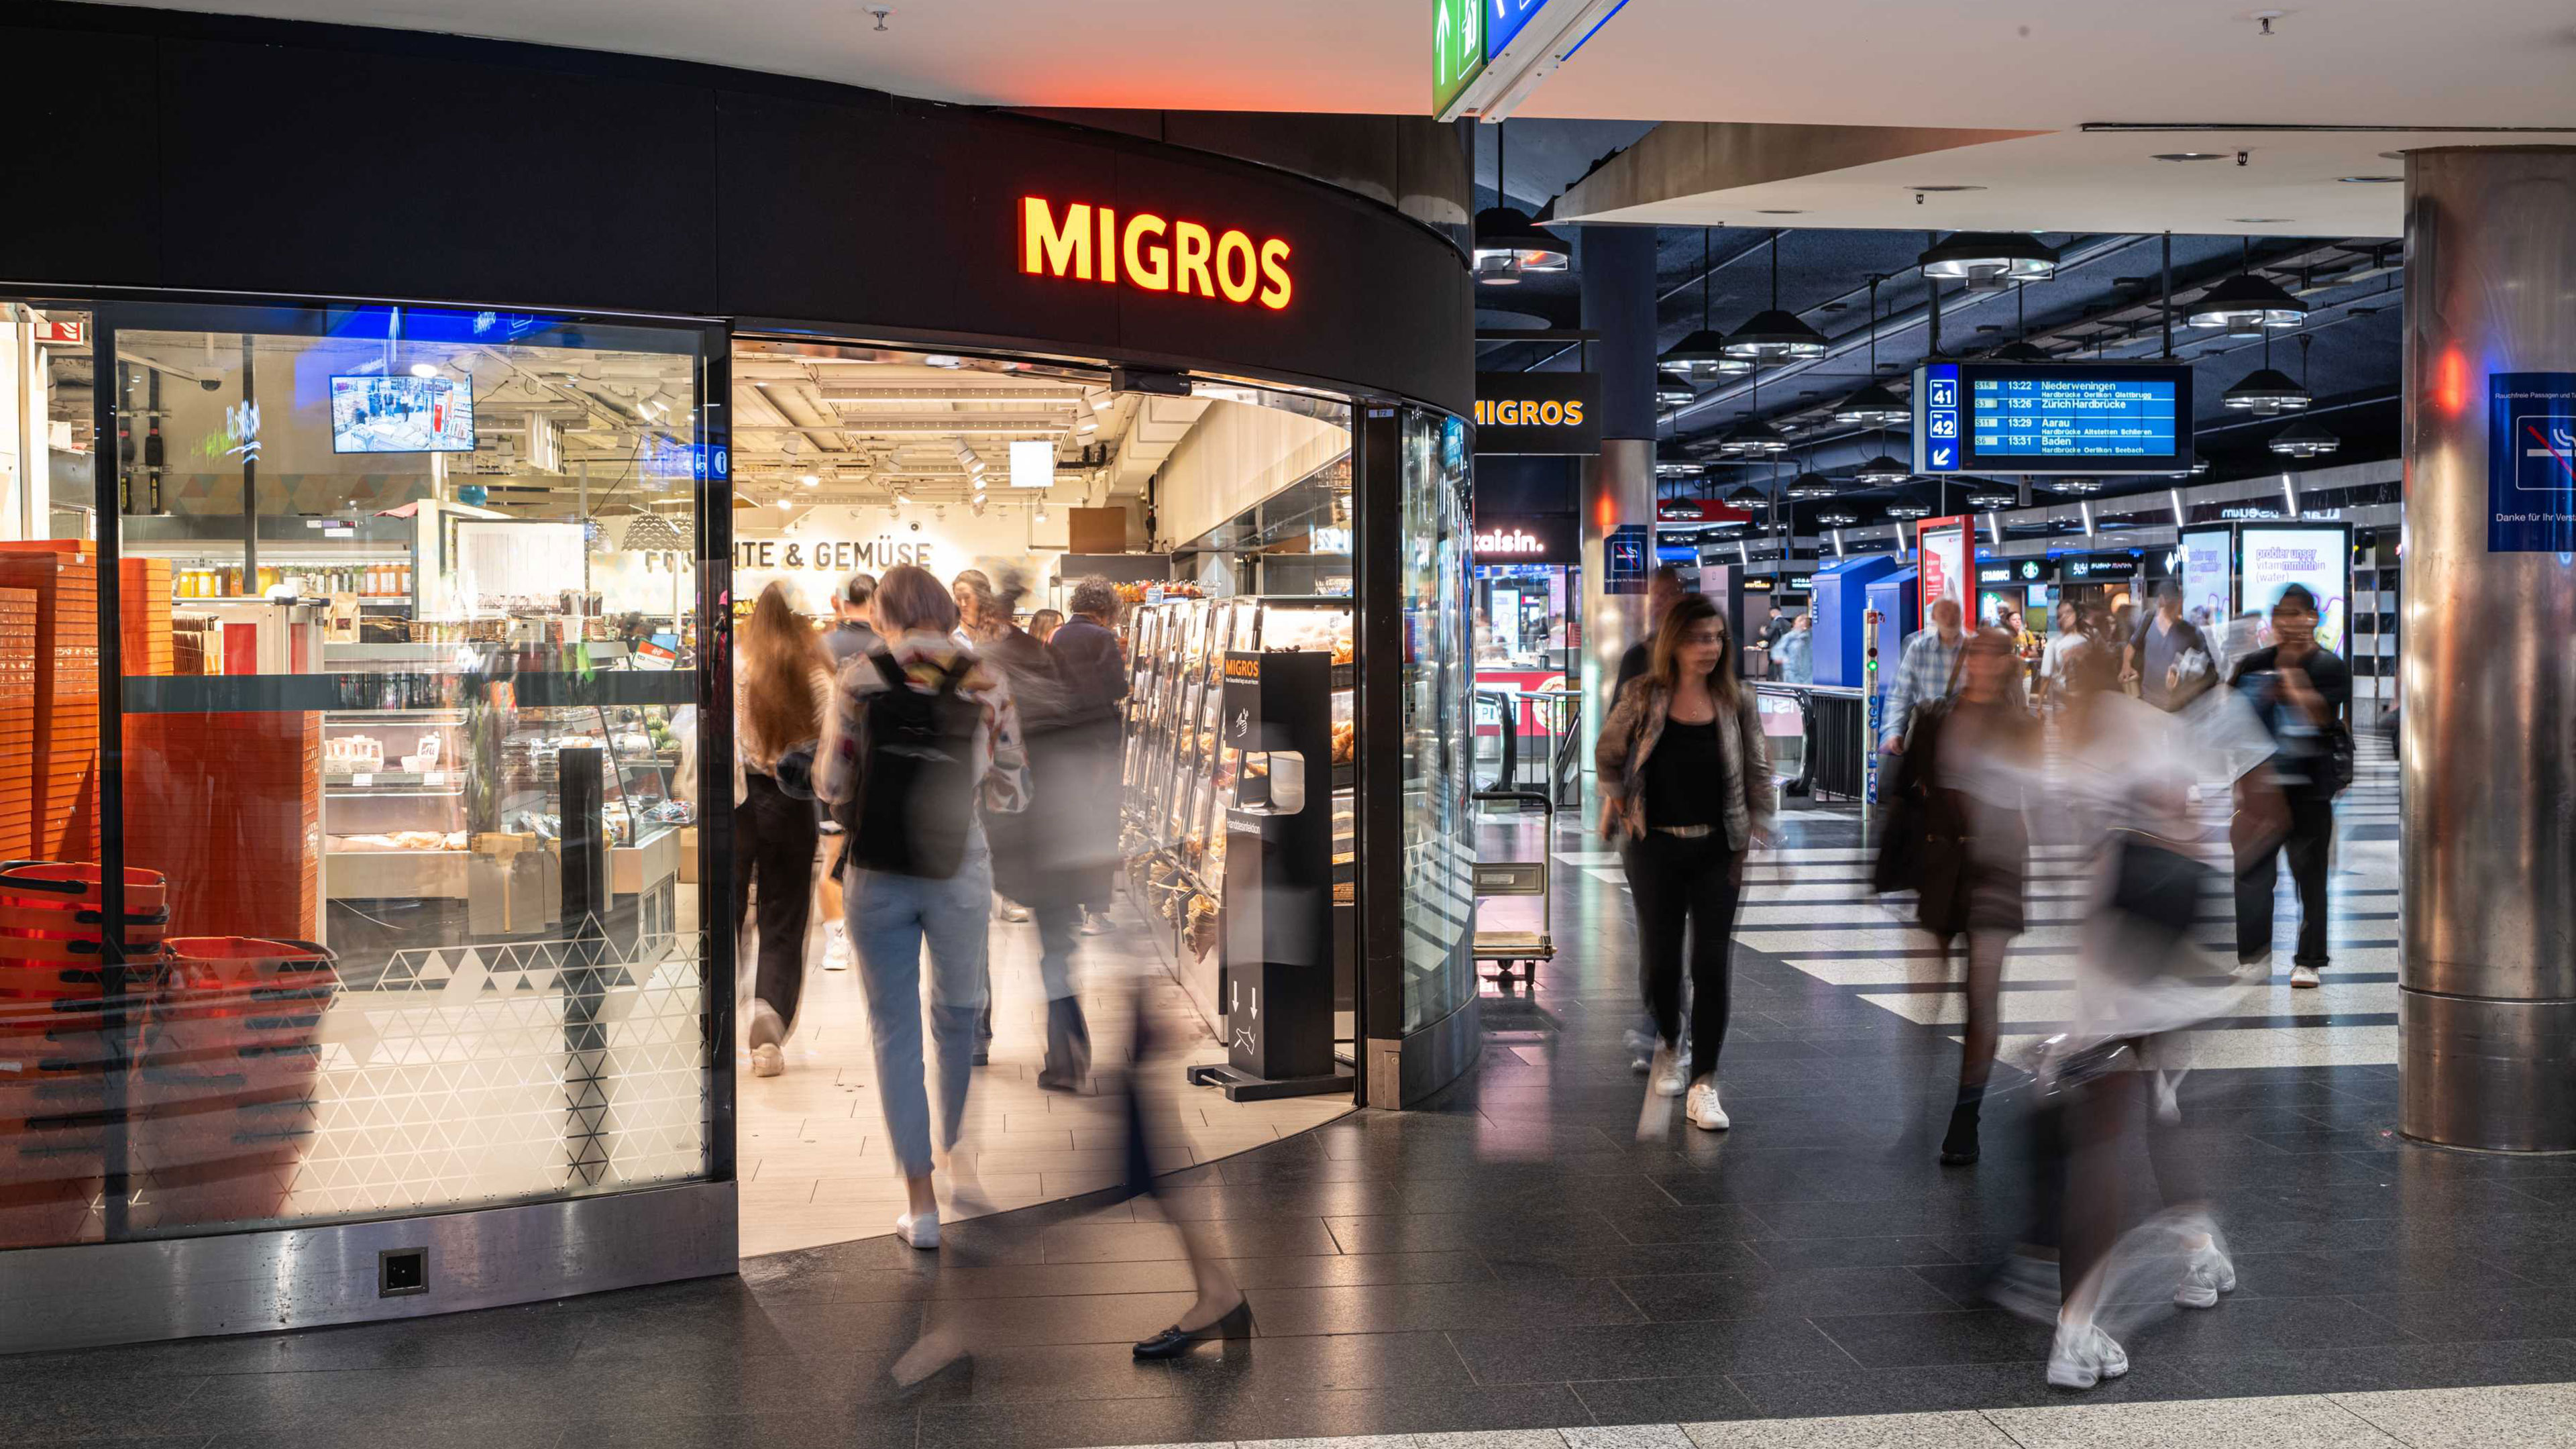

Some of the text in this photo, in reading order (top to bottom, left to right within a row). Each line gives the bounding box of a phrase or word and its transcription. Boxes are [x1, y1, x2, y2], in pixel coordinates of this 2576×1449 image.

[1020, 196, 1293, 311] MIGROS
[2008, 381, 2032, 390] 13:22
[2041, 381, 2116, 392] Niederweningen
[1933, 390, 1951, 405] 41
[2114, 391, 2152, 400] Glattbrugg
[2530, 392, 2559, 400] Passagen
[2008, 400, 2032, 409] 13:26
[2041, 398, 2071, 409] Zürich
[2072, 398, 2126, 409] Hardbrücke
[1933, 421, 1953, 435] 42
[2008, 419, 2032, 427] 13:29
[2041, 419, 2070, 427] Aarau
[2008, 437, 2031, 445] 13:31
[2041, 437, 2072, 445] Baden
[2496, 513, 2526, 522] Danke
[2528, 513, 2540, 521] für
[2542, 513, 2554, 521] Ihr
[786, 542, 805, 568] &
[814, 535, 932, 568] GEMÜSE
[2255, 547, 2317, 561] probier unser
[2255, 572, 2290, 583] (water)
[1225, 659, 1259, 678] MIGROS
[1226, 817, 1260, 835] Handdesinfektion
